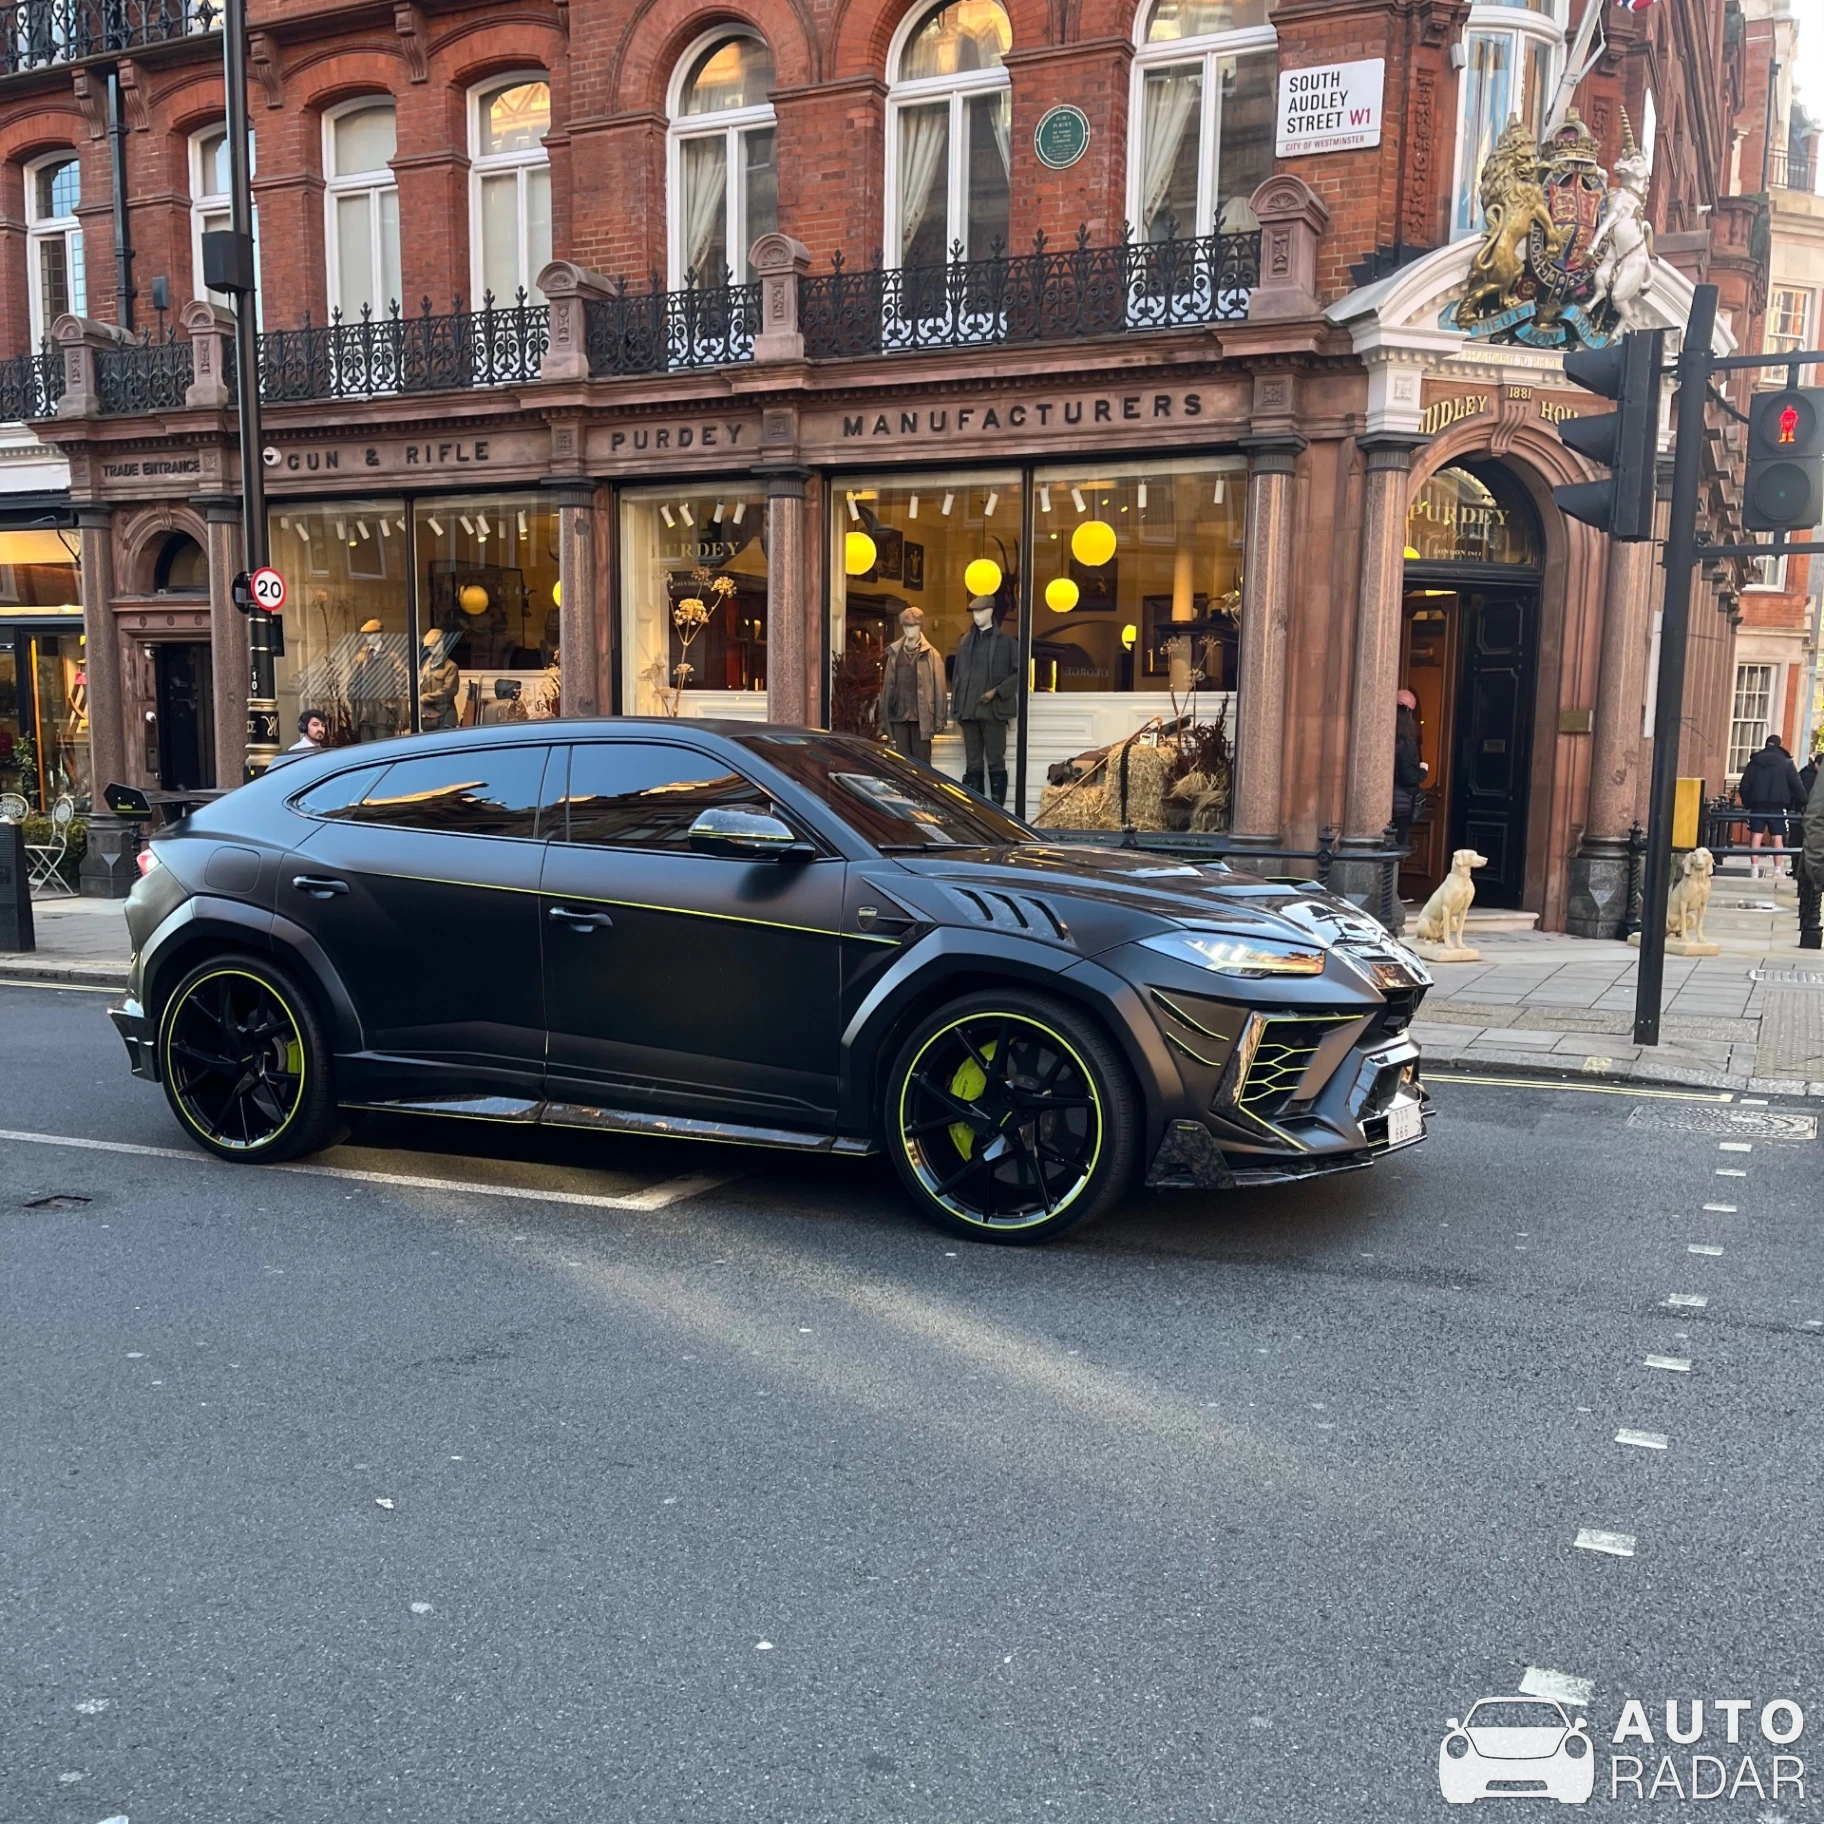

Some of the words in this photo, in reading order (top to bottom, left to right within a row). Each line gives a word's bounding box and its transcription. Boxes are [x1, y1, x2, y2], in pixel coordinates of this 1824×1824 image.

[1289, 71, 1340, 93] SOUTH
[1288, 90, 1349, 113] AUDLEY
[1287, 111, 1343, 134] STREET
[1349, 108, 1371, 126] W1
[1285, 141, 1301, 151] CITY
[1303, 141, 1312, 149] OF
[1314, 135, 1364, 148] WESTMINSTER
[1509, 387, 1532, 399] 1881
[843, 393, 1201, 437] MANUFACTURERS
[1419, 395, 1488, 434] UDLEY
[611, 424, 742, 451] PURDEY
[287, 451, 338, 470] GUN
[365, 448, 380, 466] &
[406, 441, 489, 464] RIFLE
[103, 462, 139, 477] TRADE
[142, 460, 200, 476] ENTRANCE
[1408, 503, 1510, 526] PURDEY
[257, 580, 282, 599] 20
